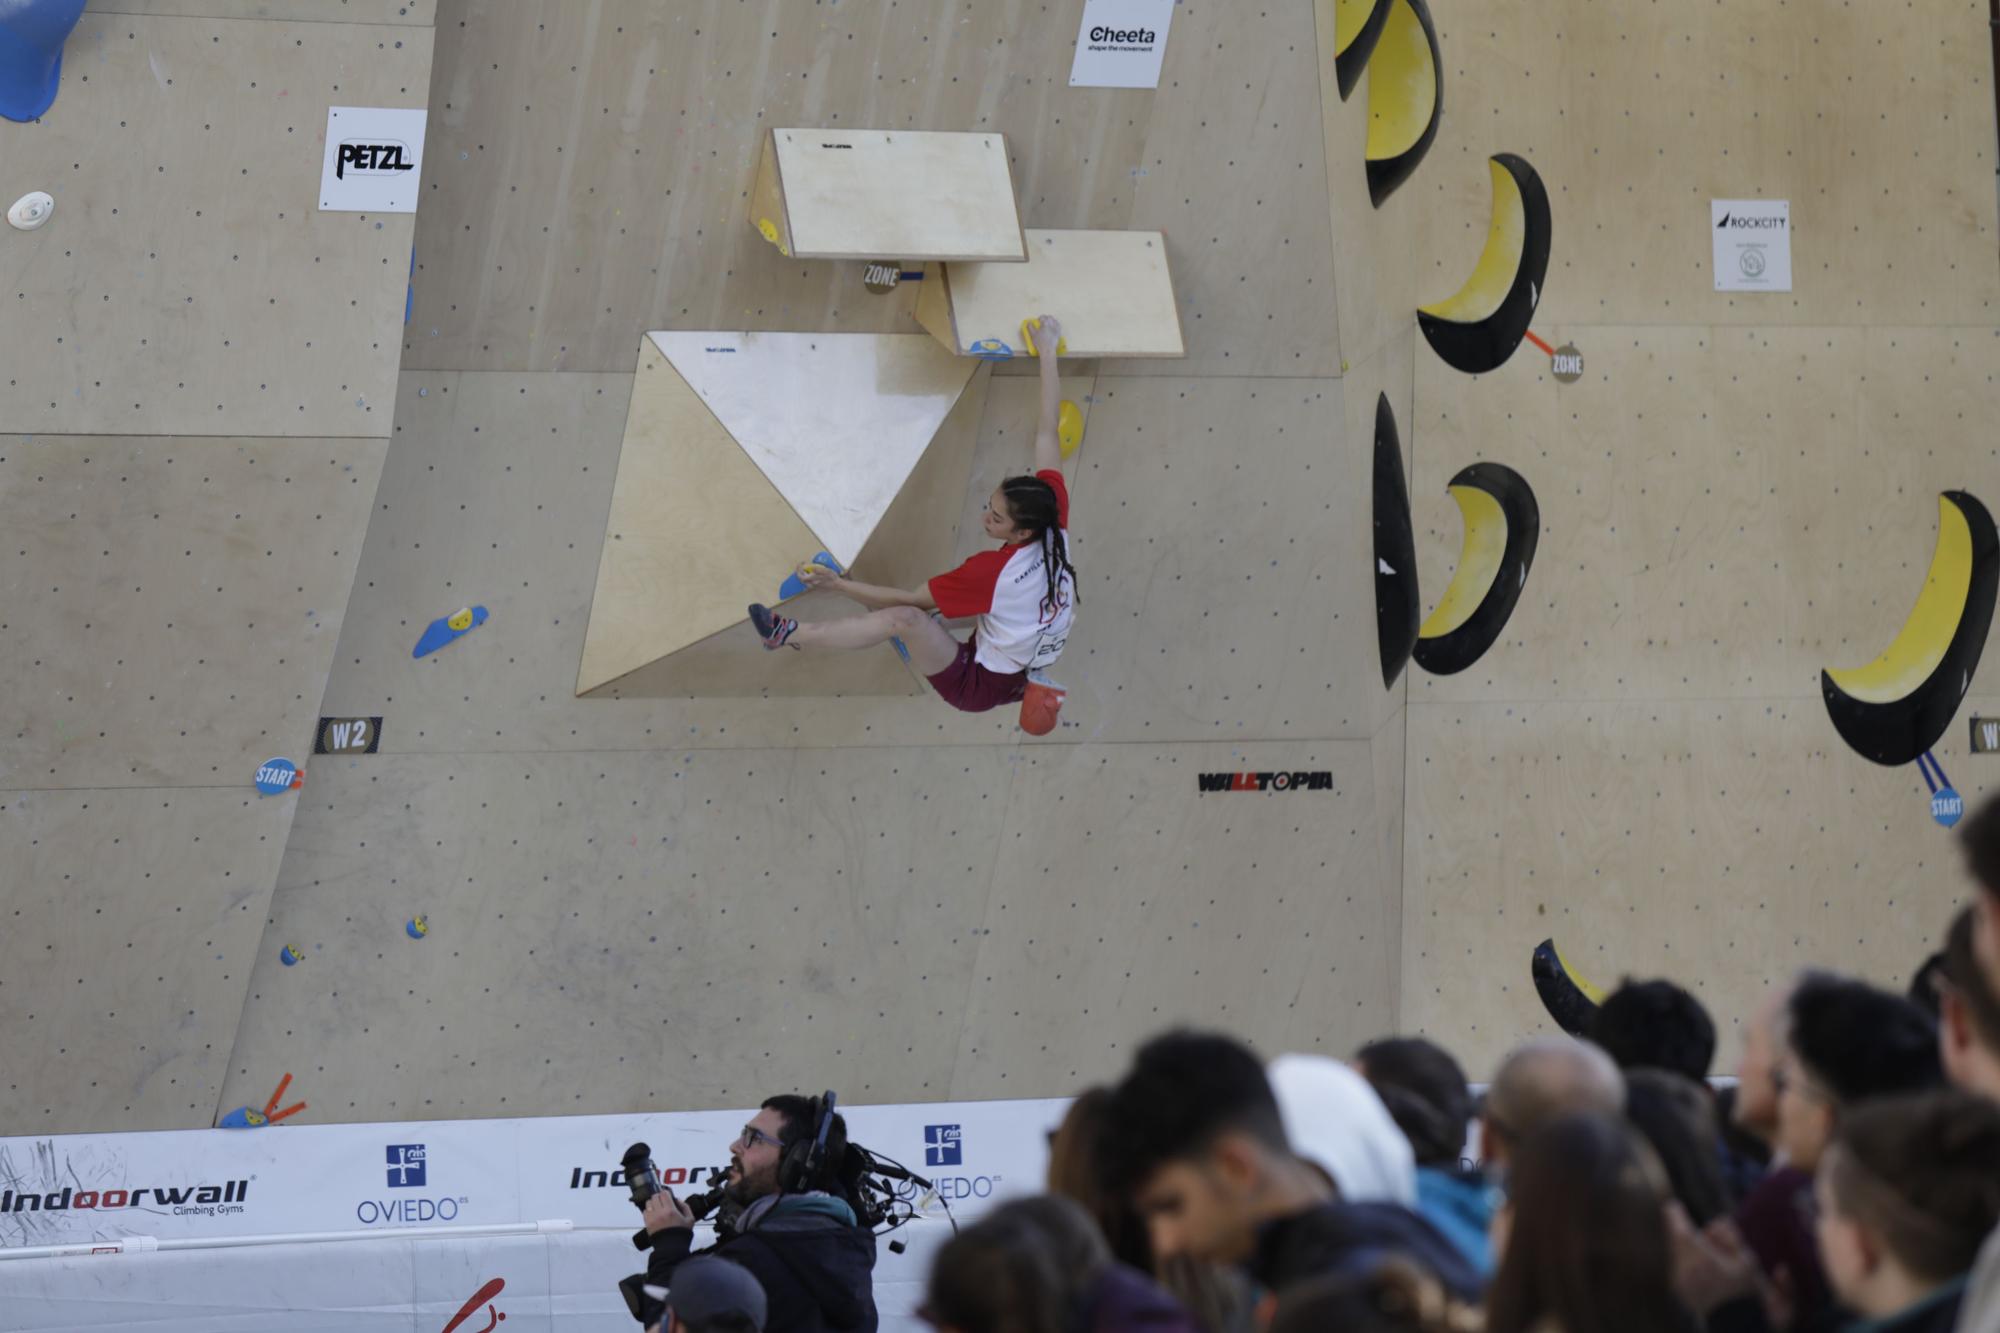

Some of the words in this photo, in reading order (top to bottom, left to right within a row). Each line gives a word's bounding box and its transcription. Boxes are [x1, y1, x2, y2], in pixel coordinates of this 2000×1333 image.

[1090, 26, 1156, 43] Cheeta
[337, 144, 414, 180] PETZL
[1731, 217, 1786, 228] ROCKCITY
[864, 264, 900, 287] ZONE
[1552, 354, 1582, 374] ZONE
[332, 720, 367, 750] W2
[256, 766, 296, 787] START
[1931, 797, 1962, 817] START
[0, 1180, 248, 1212] Indoorwall
[173, 1206, 215, 1217] Climbing
[217, 1204, 245, 1216] Gyms
[358, 1197, 458, 1224] OVIEDO
